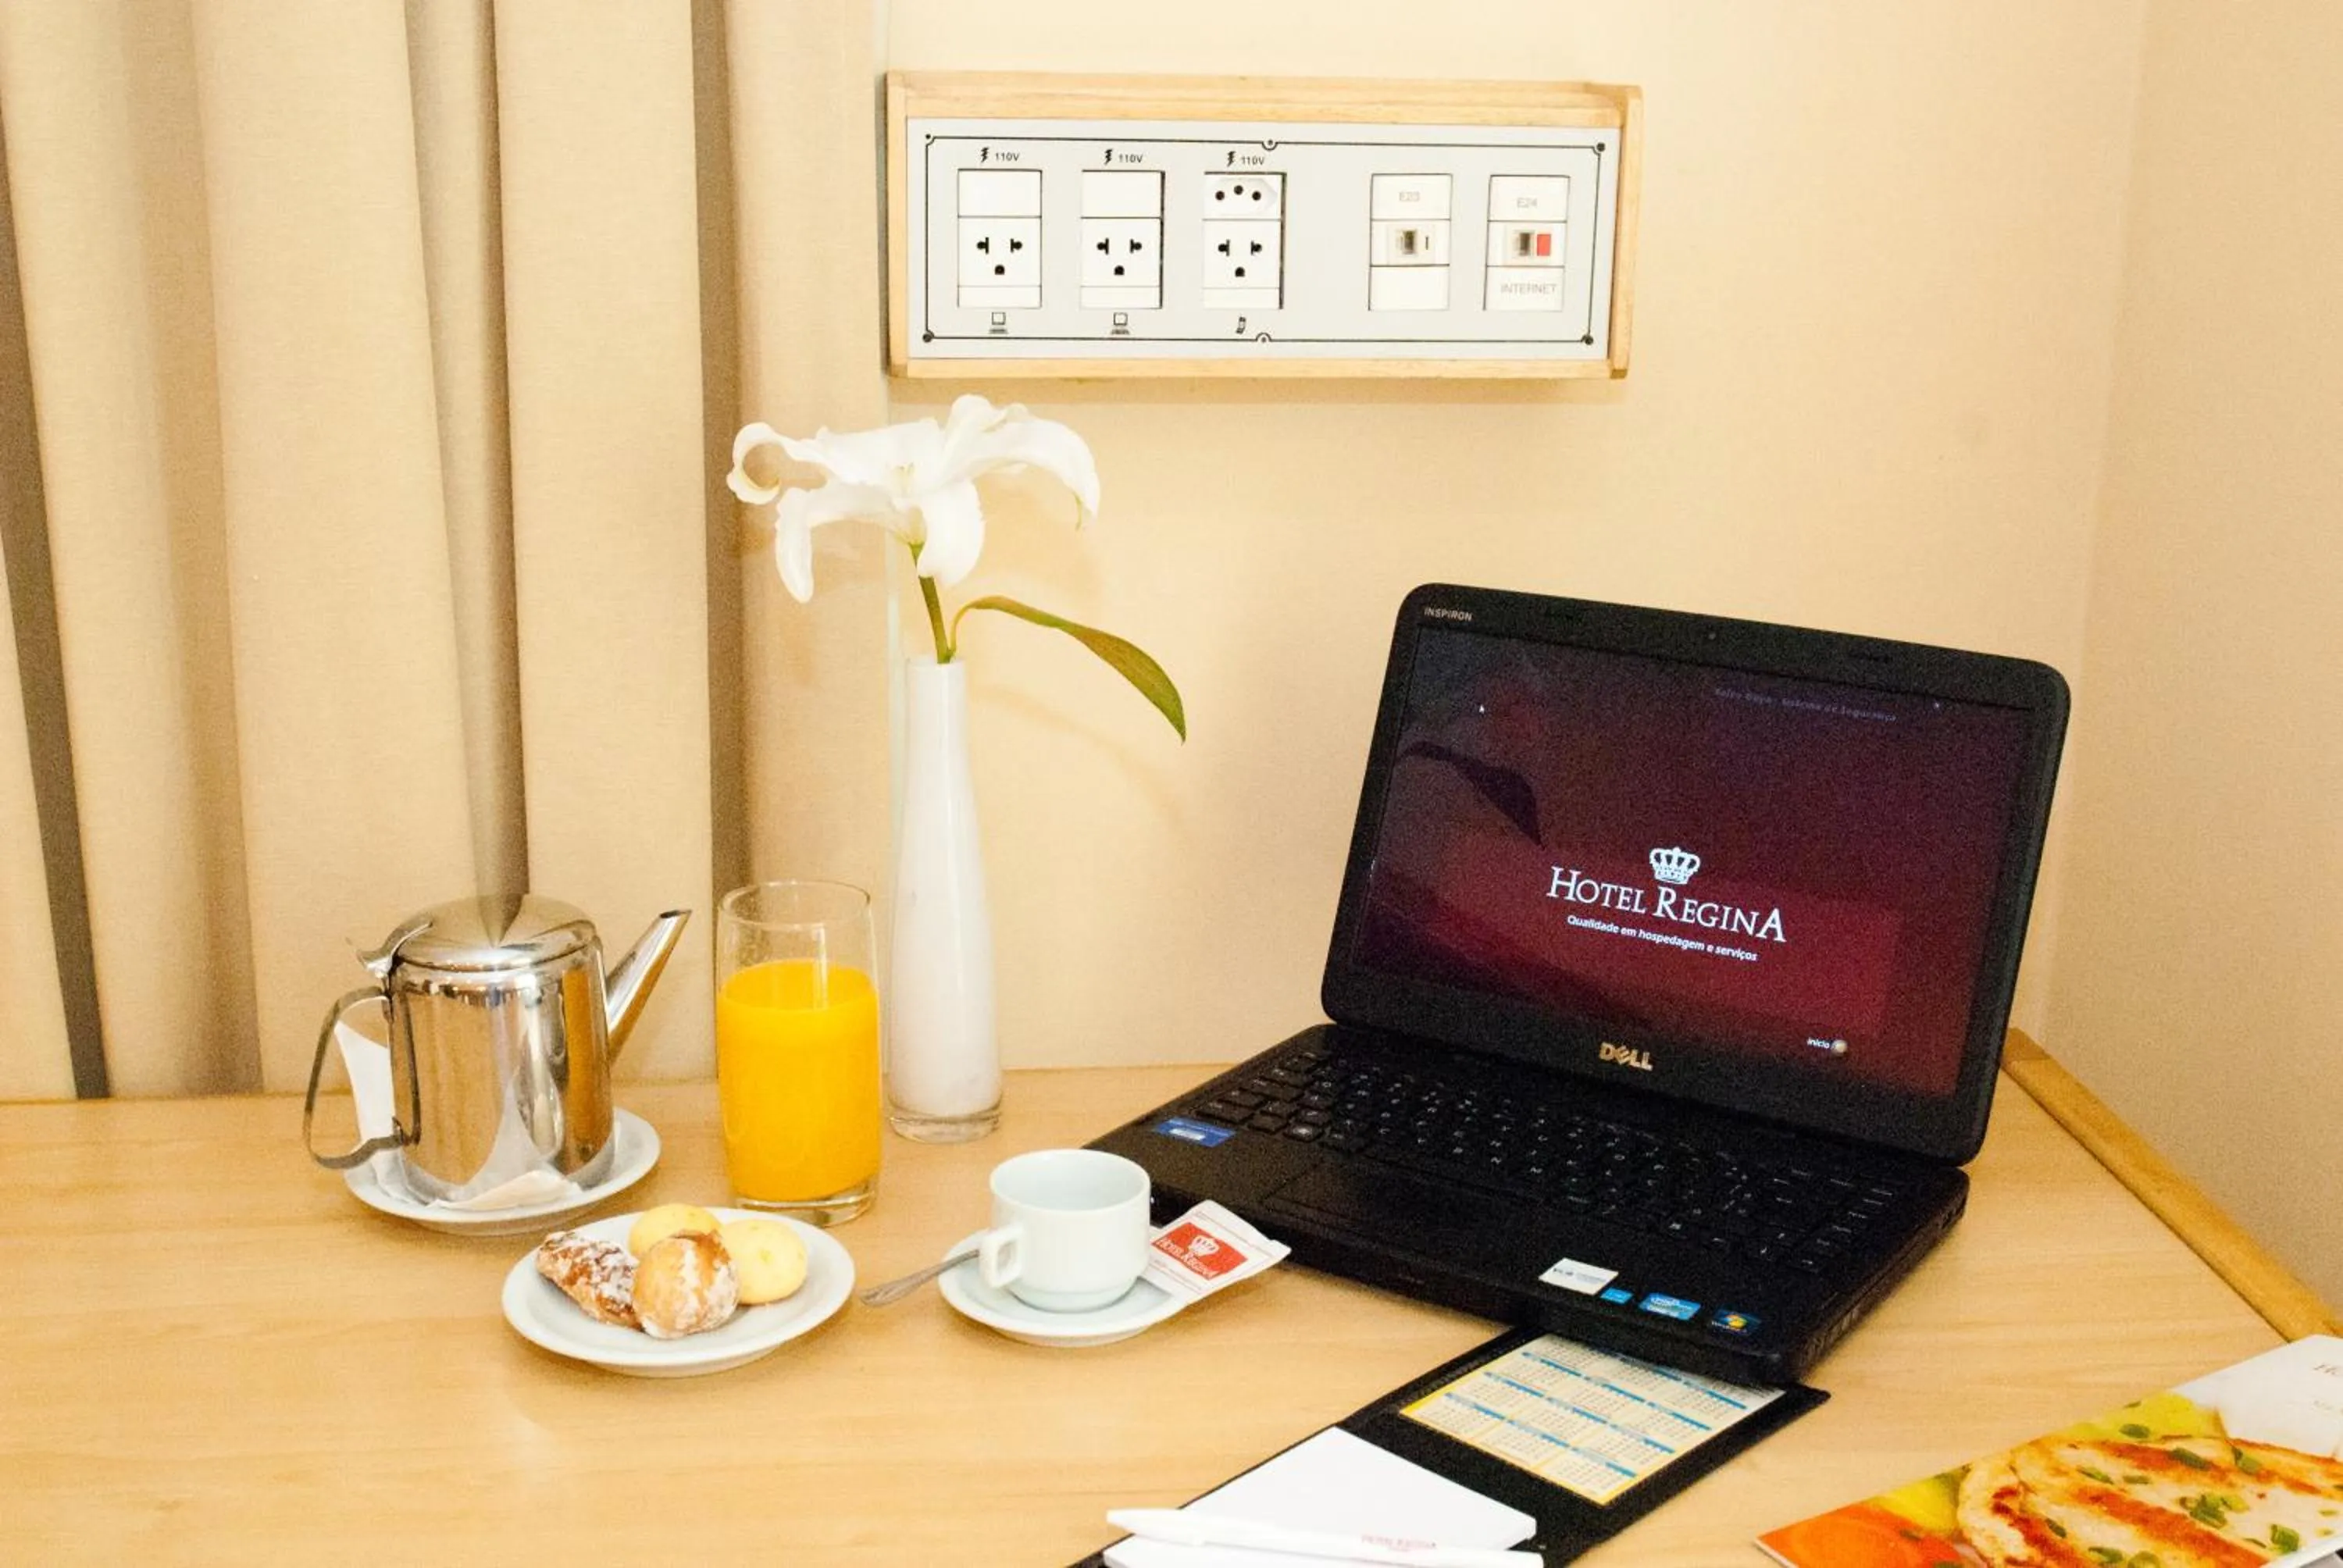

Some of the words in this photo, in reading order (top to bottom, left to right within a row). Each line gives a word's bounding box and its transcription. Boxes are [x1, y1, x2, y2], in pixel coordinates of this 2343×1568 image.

[994, 152, 1020, 162] 110V
[1118, 153, 1143, 163] 110V
[1241, 155, 1264, 165] 110V
[1501, 283, 1557, 294] INTERNET
[1424, 607, 1473, 622] INSPIRON
[1546, 866, 1646, 914] HOTEL
[1653, 886, 1786, 943] REGINA
[1567, 915, 1619, 934] Qualidade
[1621, 926, 1637, 937] em
[1639, 928, 1705, 950] hospedagem
[1706, 943, 1714, 952] e
[1715, 945, 1758, 962] serviços
[1599, 1042, 1653, 1071] DELL
